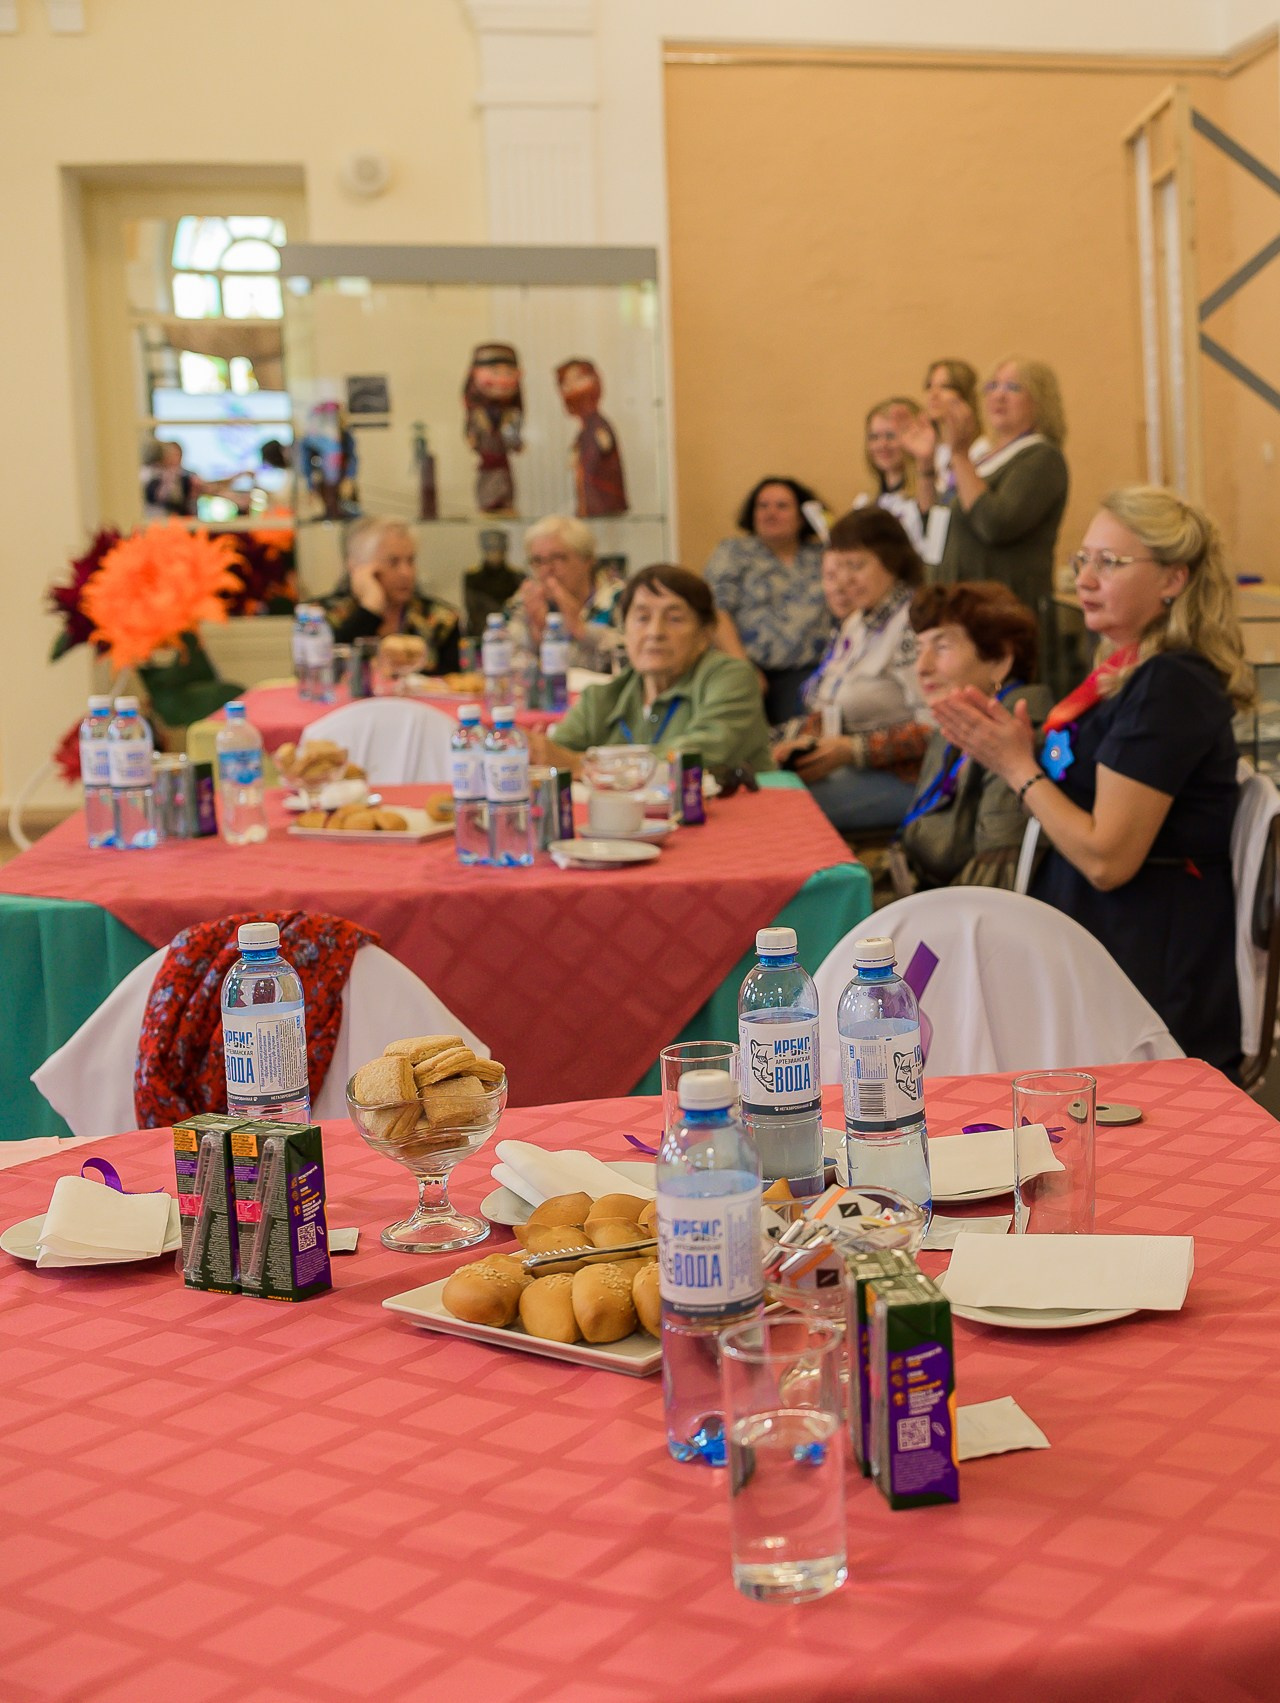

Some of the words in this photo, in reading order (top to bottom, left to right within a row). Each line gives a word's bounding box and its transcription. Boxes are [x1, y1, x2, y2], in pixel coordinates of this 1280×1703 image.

[774, 1036, 811, 1057] ИРБИС
[226, 1055, 255, 1084] ВОДА
[775, 1055, 811, 1065] АРТЕЗИАНСКАЯ
[774, 1063, 811, 1093] ВОДА
[673, 1218, 723, 1241] ИРБИС
[674, 1252, 722, 1288] ВОДА
